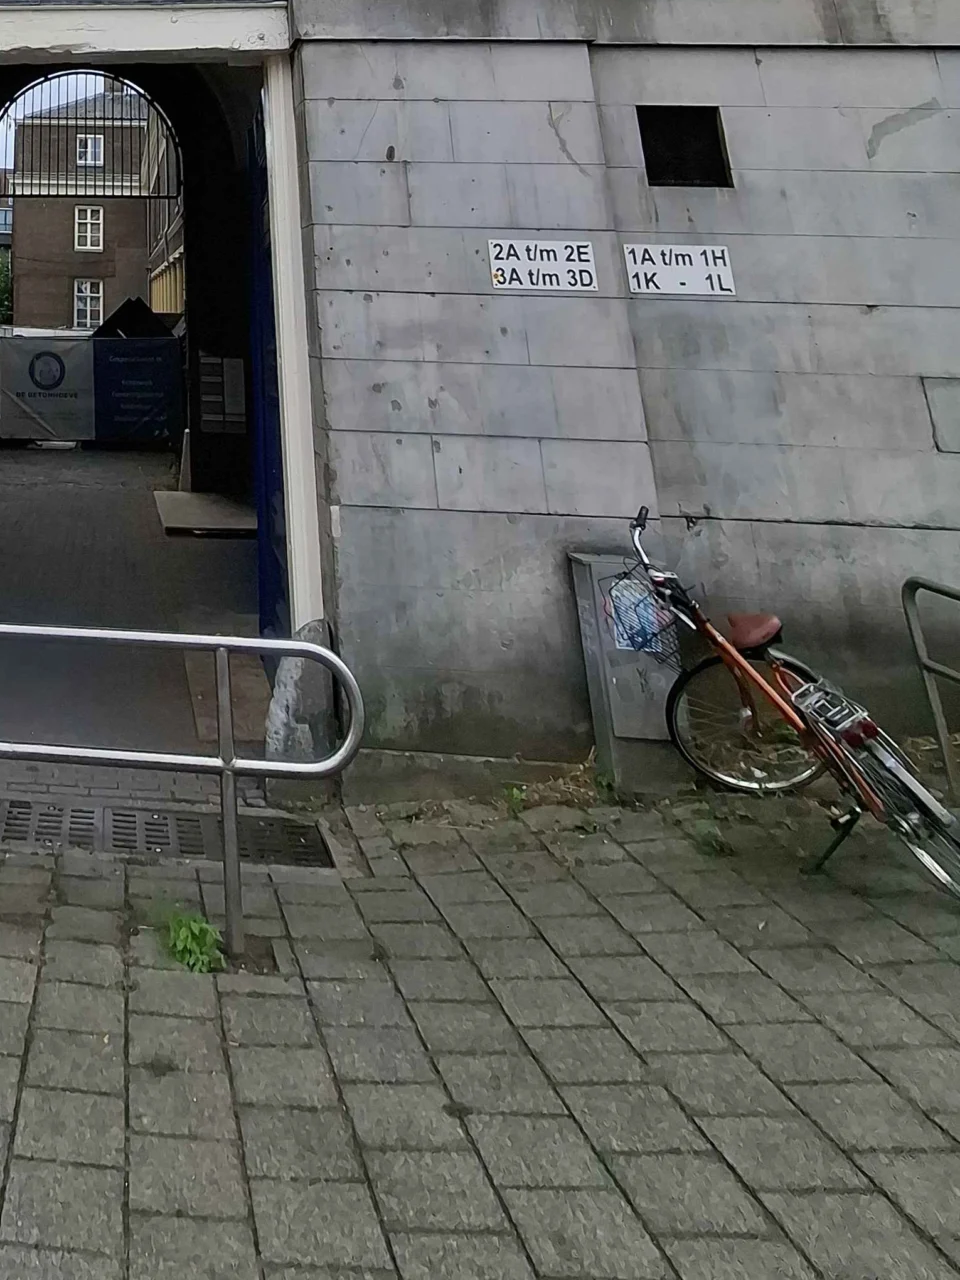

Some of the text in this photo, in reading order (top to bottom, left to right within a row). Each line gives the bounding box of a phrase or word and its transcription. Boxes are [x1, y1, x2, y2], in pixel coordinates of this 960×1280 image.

[493, 243, 591, 263] 2A t/m 2E
[628, 247, 727, 267] 1A t/m 1H
[496, 267, 593, 287] 3A t/m 3D
[632, 272, 661, 290] 1K
[705, 273, 733, 292] 1L
